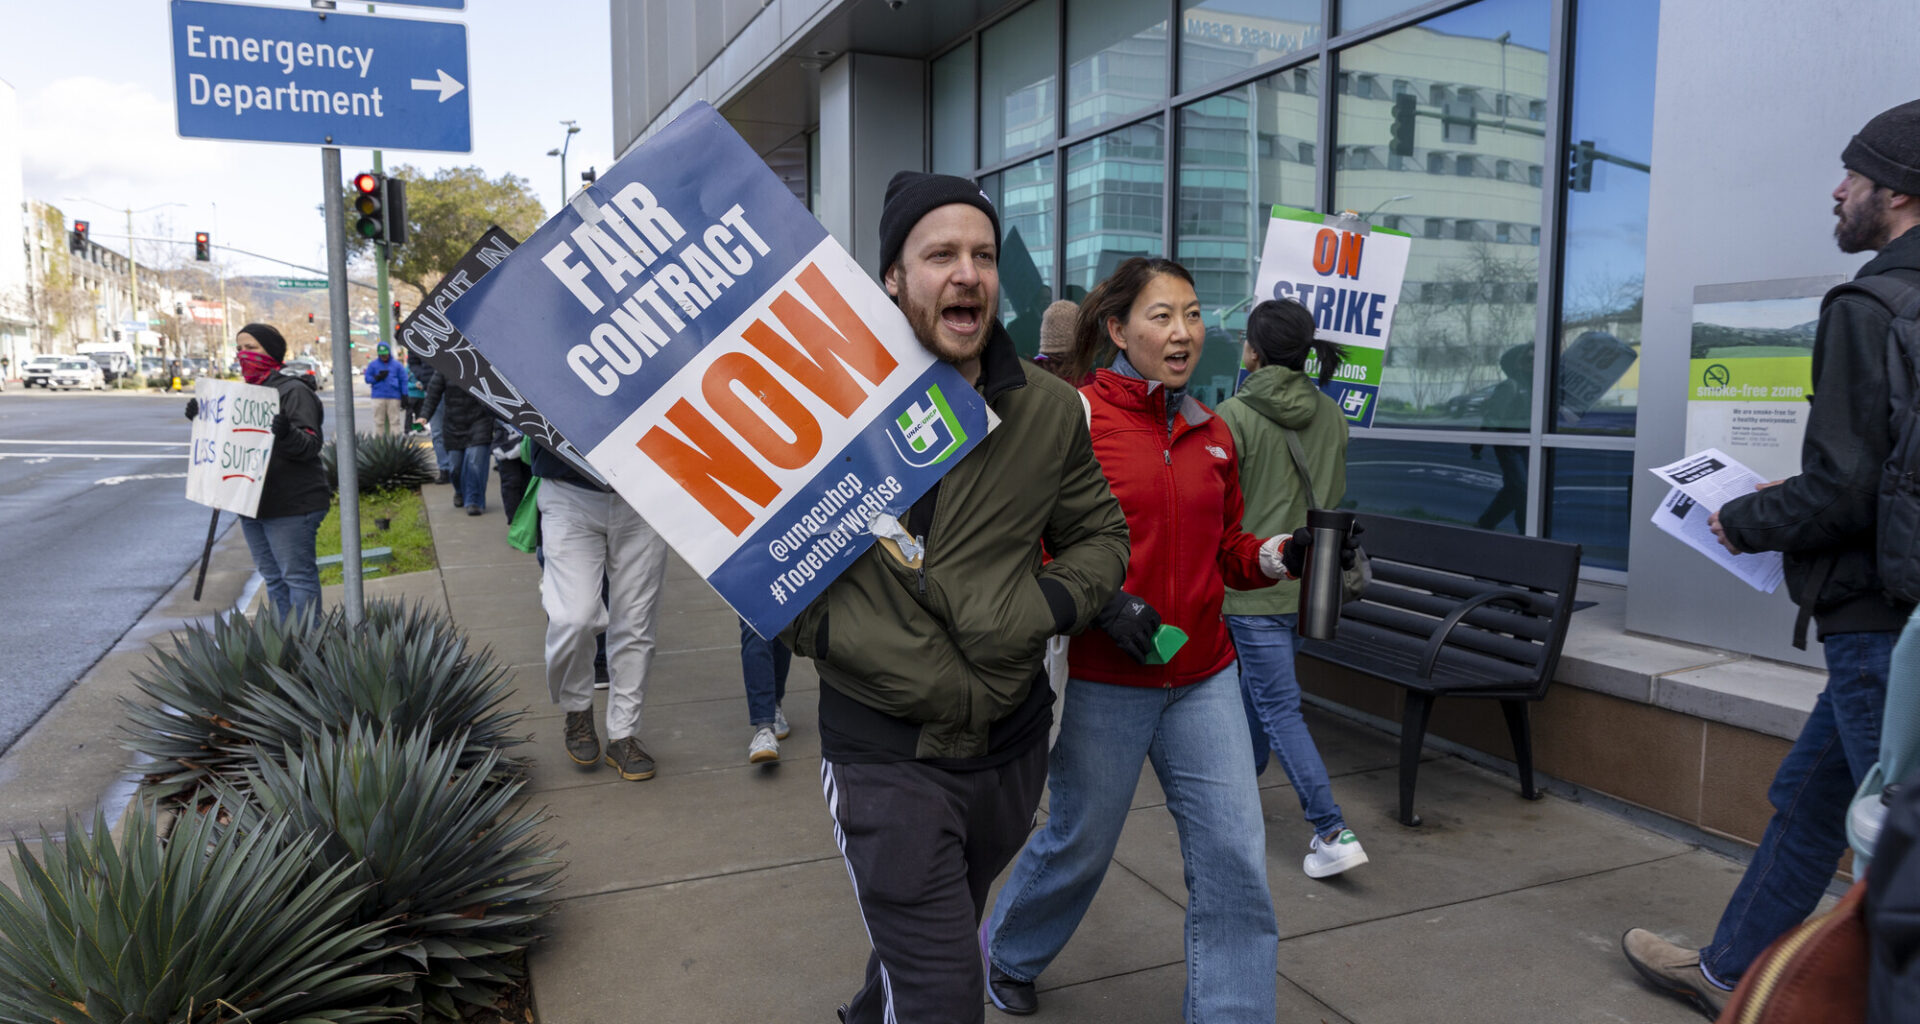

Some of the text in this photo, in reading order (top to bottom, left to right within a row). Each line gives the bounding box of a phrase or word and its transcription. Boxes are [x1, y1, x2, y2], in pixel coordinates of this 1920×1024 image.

[187, 25, 374, 78] Emergency
[189, 73, 384, 118] Department
[476, 235, 513, 270] IN
[540, 181, 687, 315] FAIR
[1312, 227, 1365, 281] ON
[566, 203, 772, 397] CONTRACT
[1304, 357, 1367, 381] ofsions
[1696, 384, 1804, 398] smoke-free zone
[199, 394, 277, 429] MRE SCRUBS
[635, 261, 900, 538] NOW
[193, 438, 269, 481] LSS SUITS!
[768, 471, 864, 562] @unacuhcp
[769, 475, 903, 605] #TogetherWeRise
